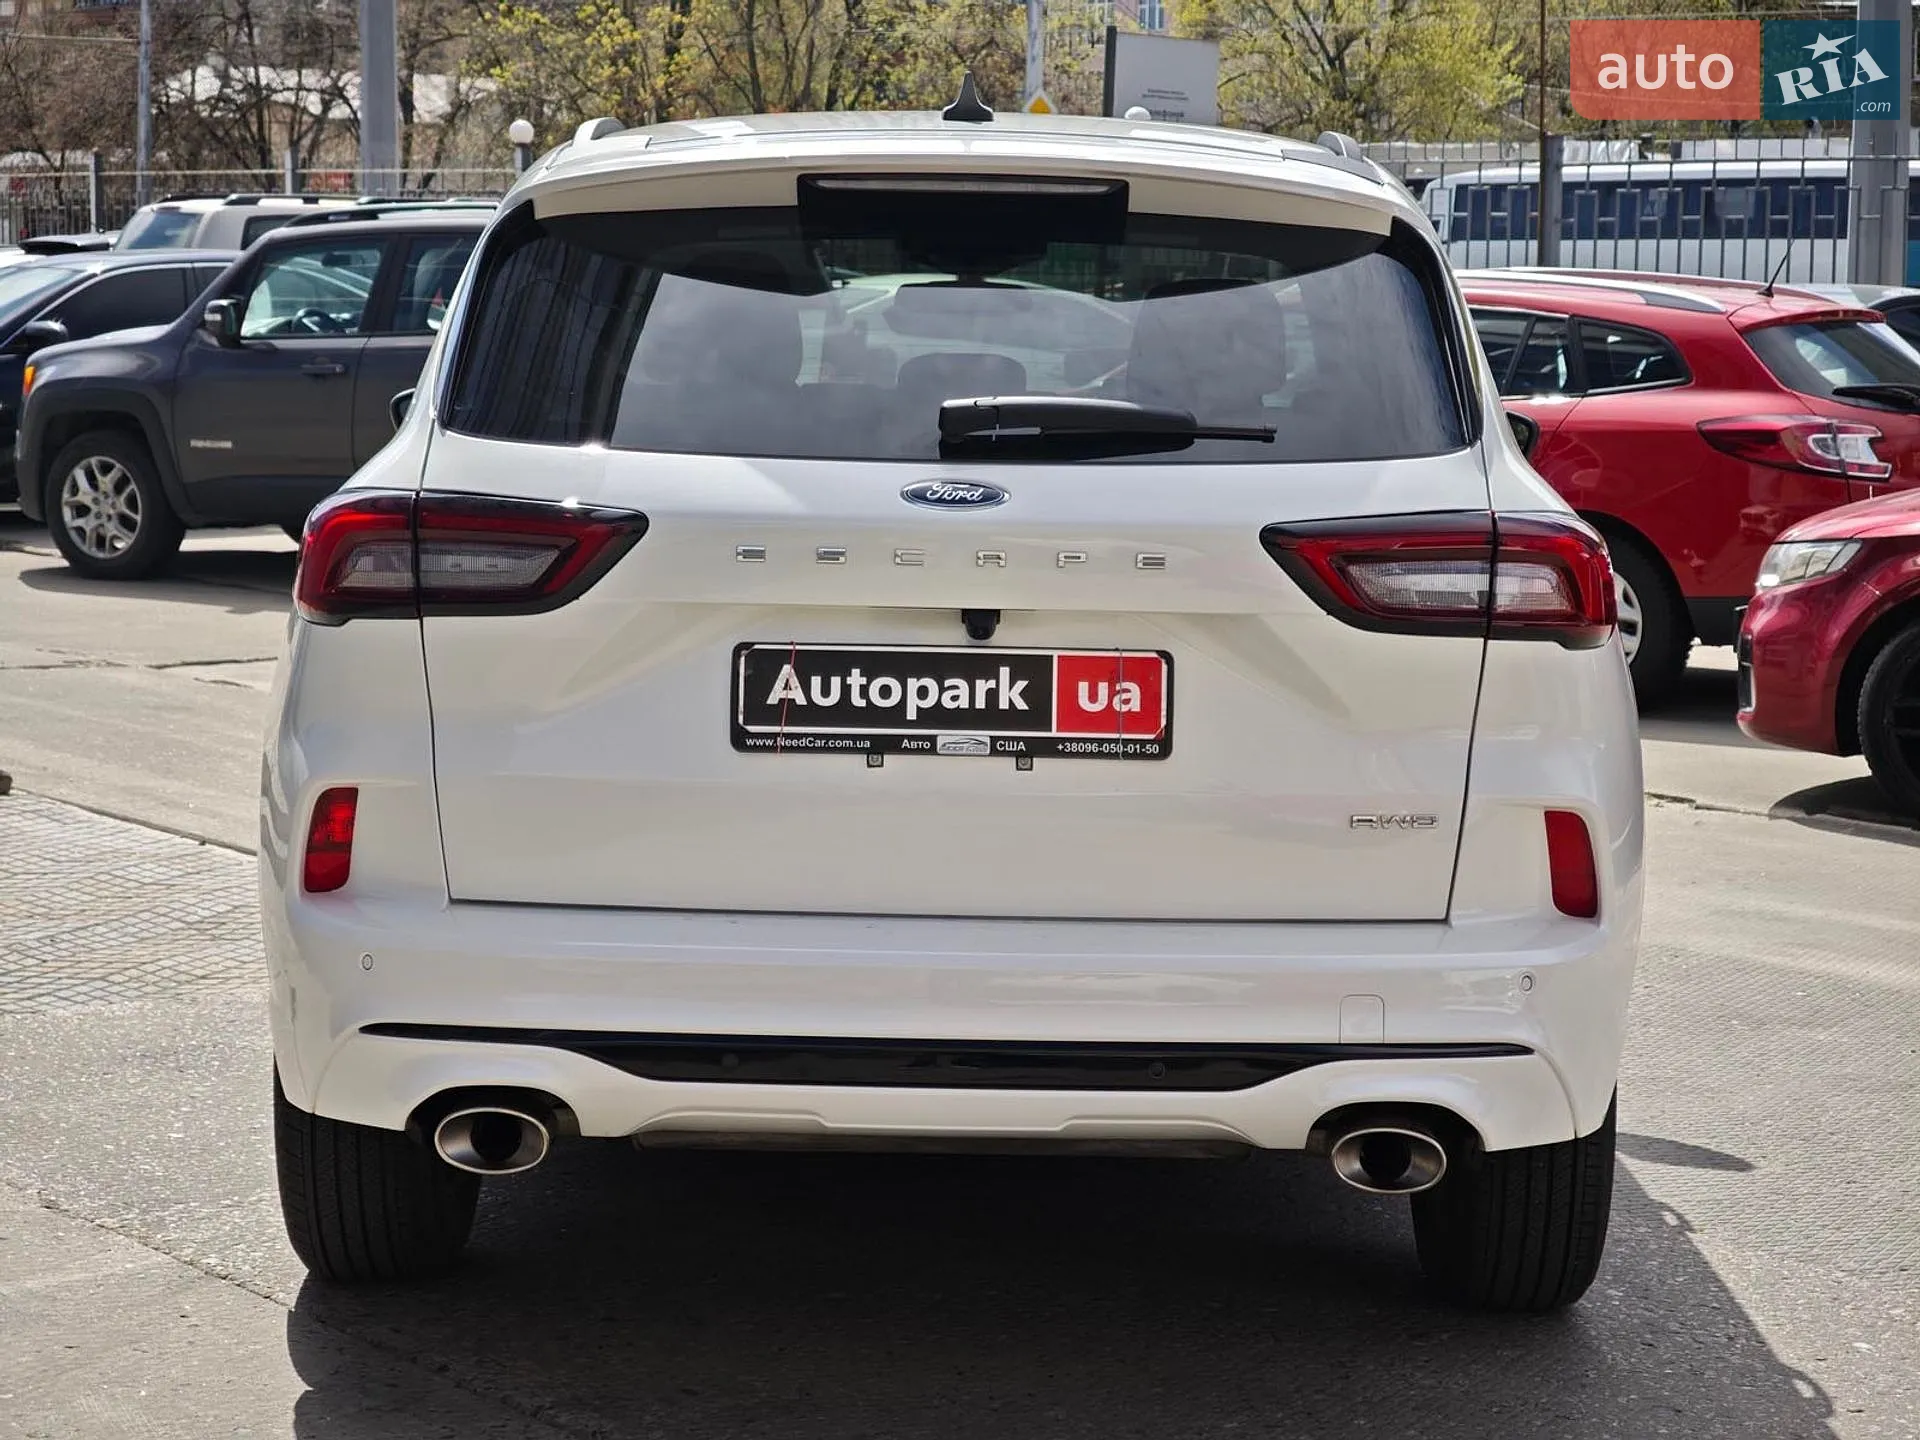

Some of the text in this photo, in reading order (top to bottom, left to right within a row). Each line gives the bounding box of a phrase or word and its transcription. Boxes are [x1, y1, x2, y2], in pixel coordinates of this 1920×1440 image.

[926, 483, 983, 501] Ford
[735, 544, 1167, 569] ESCAPE
[766, 664, 1142, 720] Autopark ua
[745, 736, 871, 749] www.NeedCar.com.ua
[901, 738, 931, 749] Авто
[996, 740, 1026, 752] США
[1056, 742, 1160, 755] +38096-050-01-50
